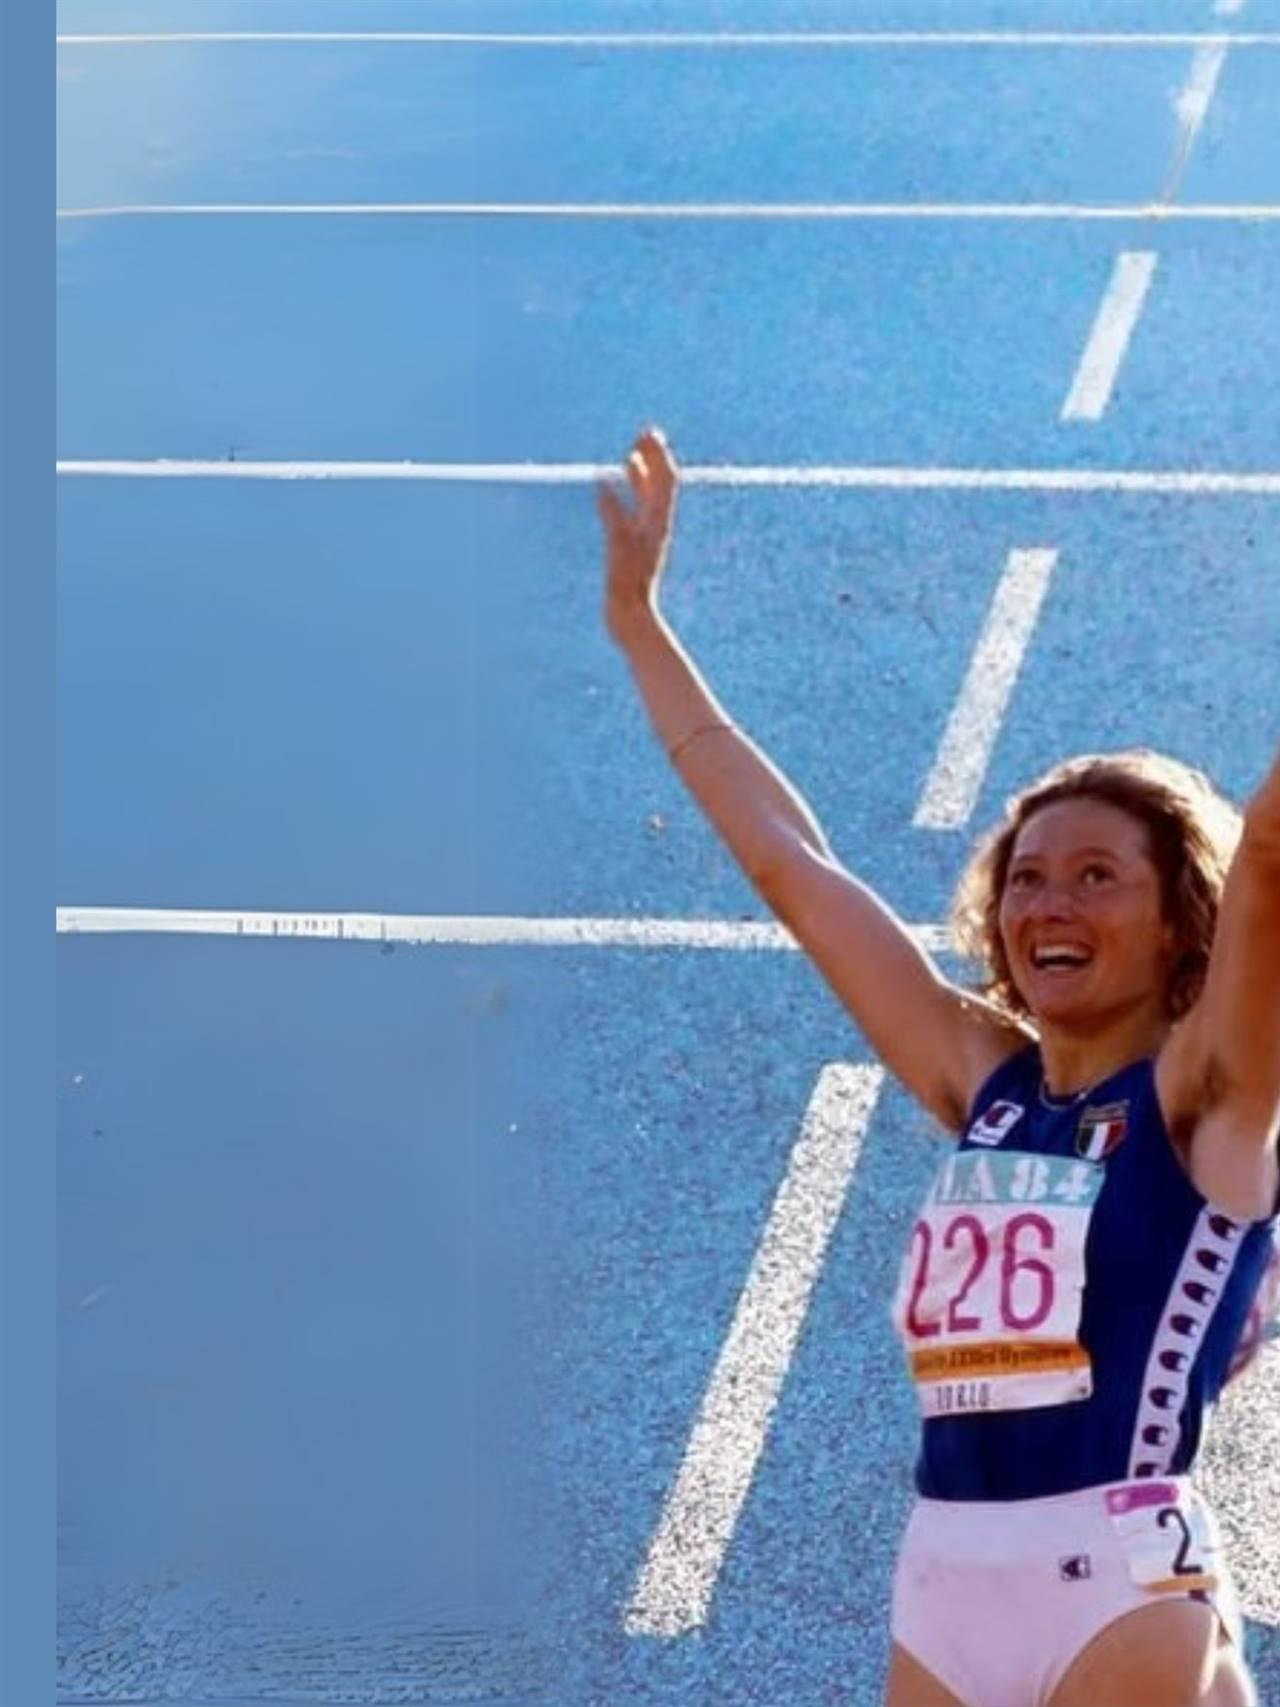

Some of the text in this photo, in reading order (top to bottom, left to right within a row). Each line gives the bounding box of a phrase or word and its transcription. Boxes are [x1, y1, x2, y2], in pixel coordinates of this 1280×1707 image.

[1009, 1157, 1092, 1202] 84
[906, 1213, 1055, 1338] 226
[1156, 1506, 1203, 1576] 2
